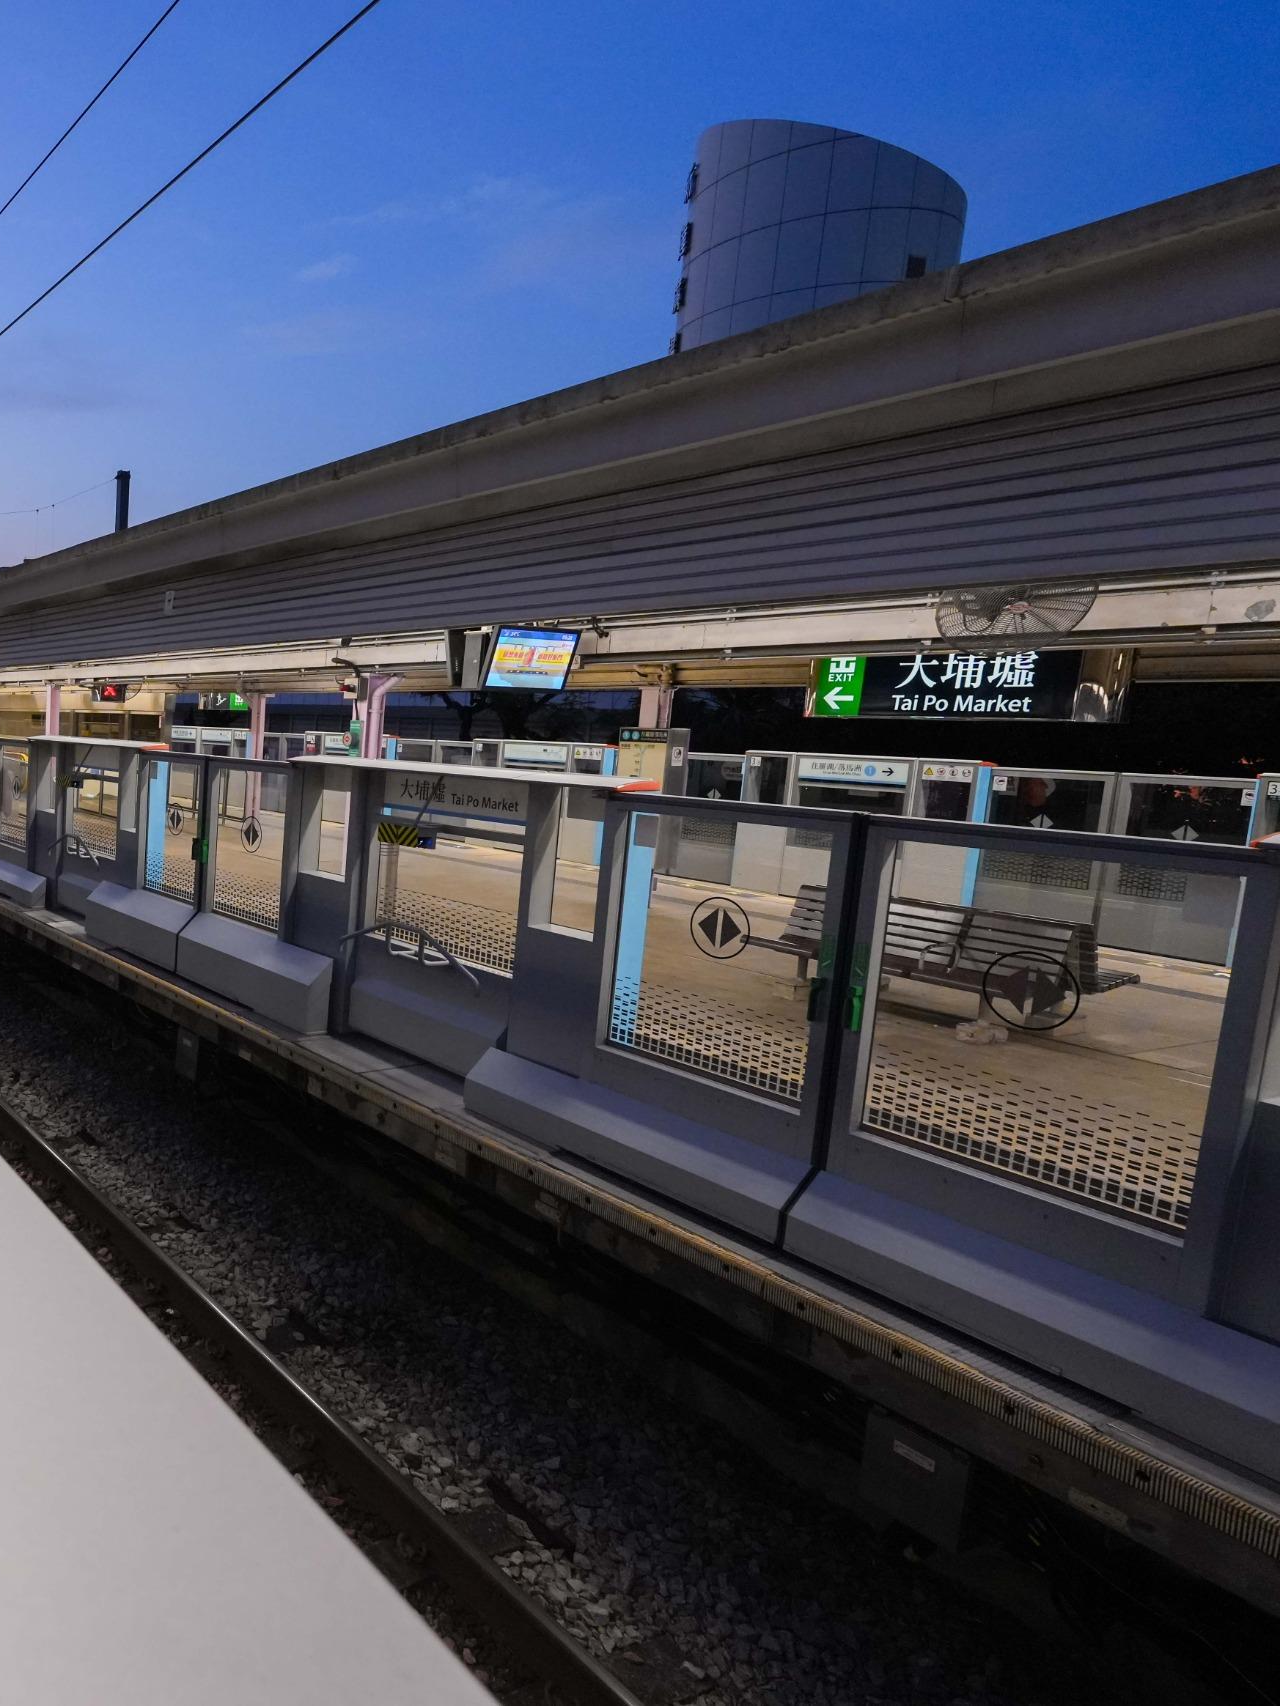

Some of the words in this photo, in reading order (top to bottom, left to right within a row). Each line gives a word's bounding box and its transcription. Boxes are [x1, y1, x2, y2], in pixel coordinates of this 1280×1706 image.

[828, 673, 855, 682] EXIT
[894, 651, 1040, 689] 大埔墟
[891, 694, 918, 711] Tai
[923, 695, 948, 712] Po
[953, 696, 1032, 713] Market
[400, 778, 447, 803] 大埔墟
[451, 793, 464, 806] Tai
[466, 795, 479, 808] Po
[481, 797, 519, 812] Market
